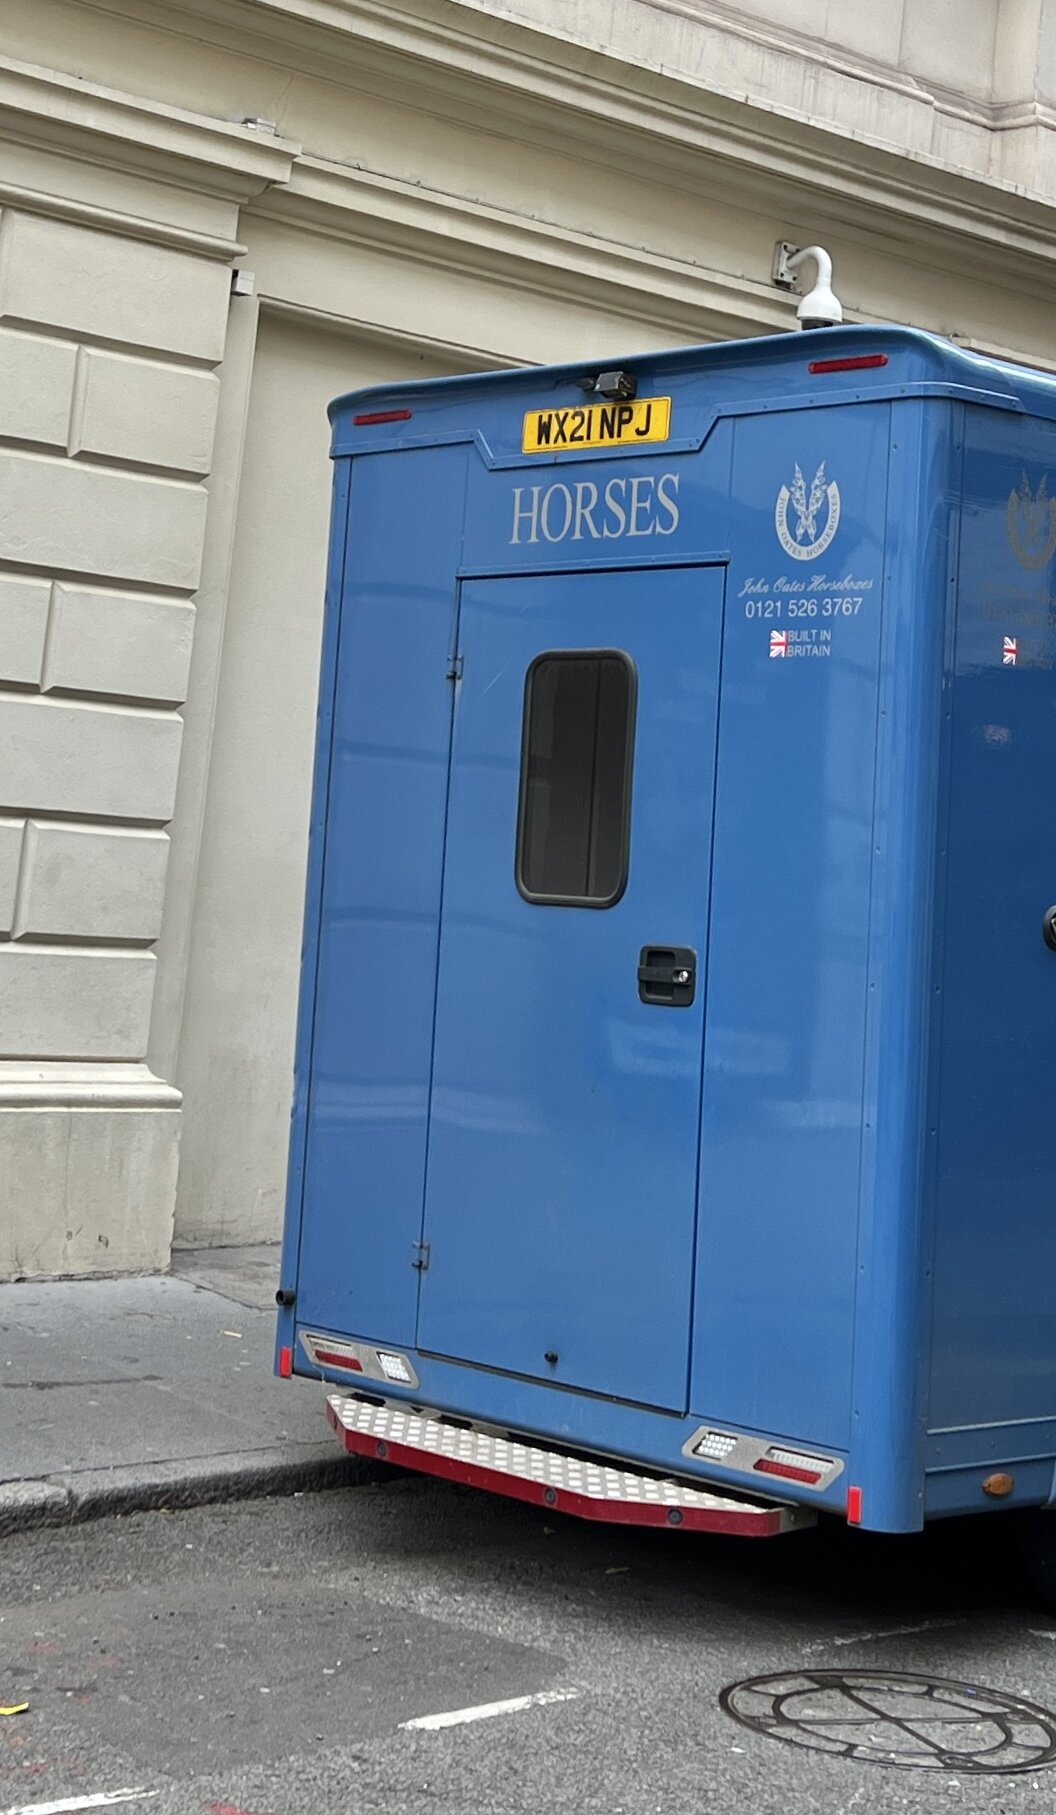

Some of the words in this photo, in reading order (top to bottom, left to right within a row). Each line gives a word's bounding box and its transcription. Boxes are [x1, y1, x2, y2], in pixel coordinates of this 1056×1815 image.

[537, 409, 592, 445] WX21
[600, 404, 652, 440] NPJ
[509, 473, 680, 544] HORSES
[738, 577, 769, 598] John
[773, 576, 805, 593] Oates
[807, 574, 873, 592] Horseboxes
[745, 600, 781, 618] 0121
[788, 599, 817, 617] 526
[822, 597, 863, 616] 3767
[787, 629, 818, 643] BUILT
[820, 629, 832, 642] IN
[786, 644, 831, 657] BRITAIN
